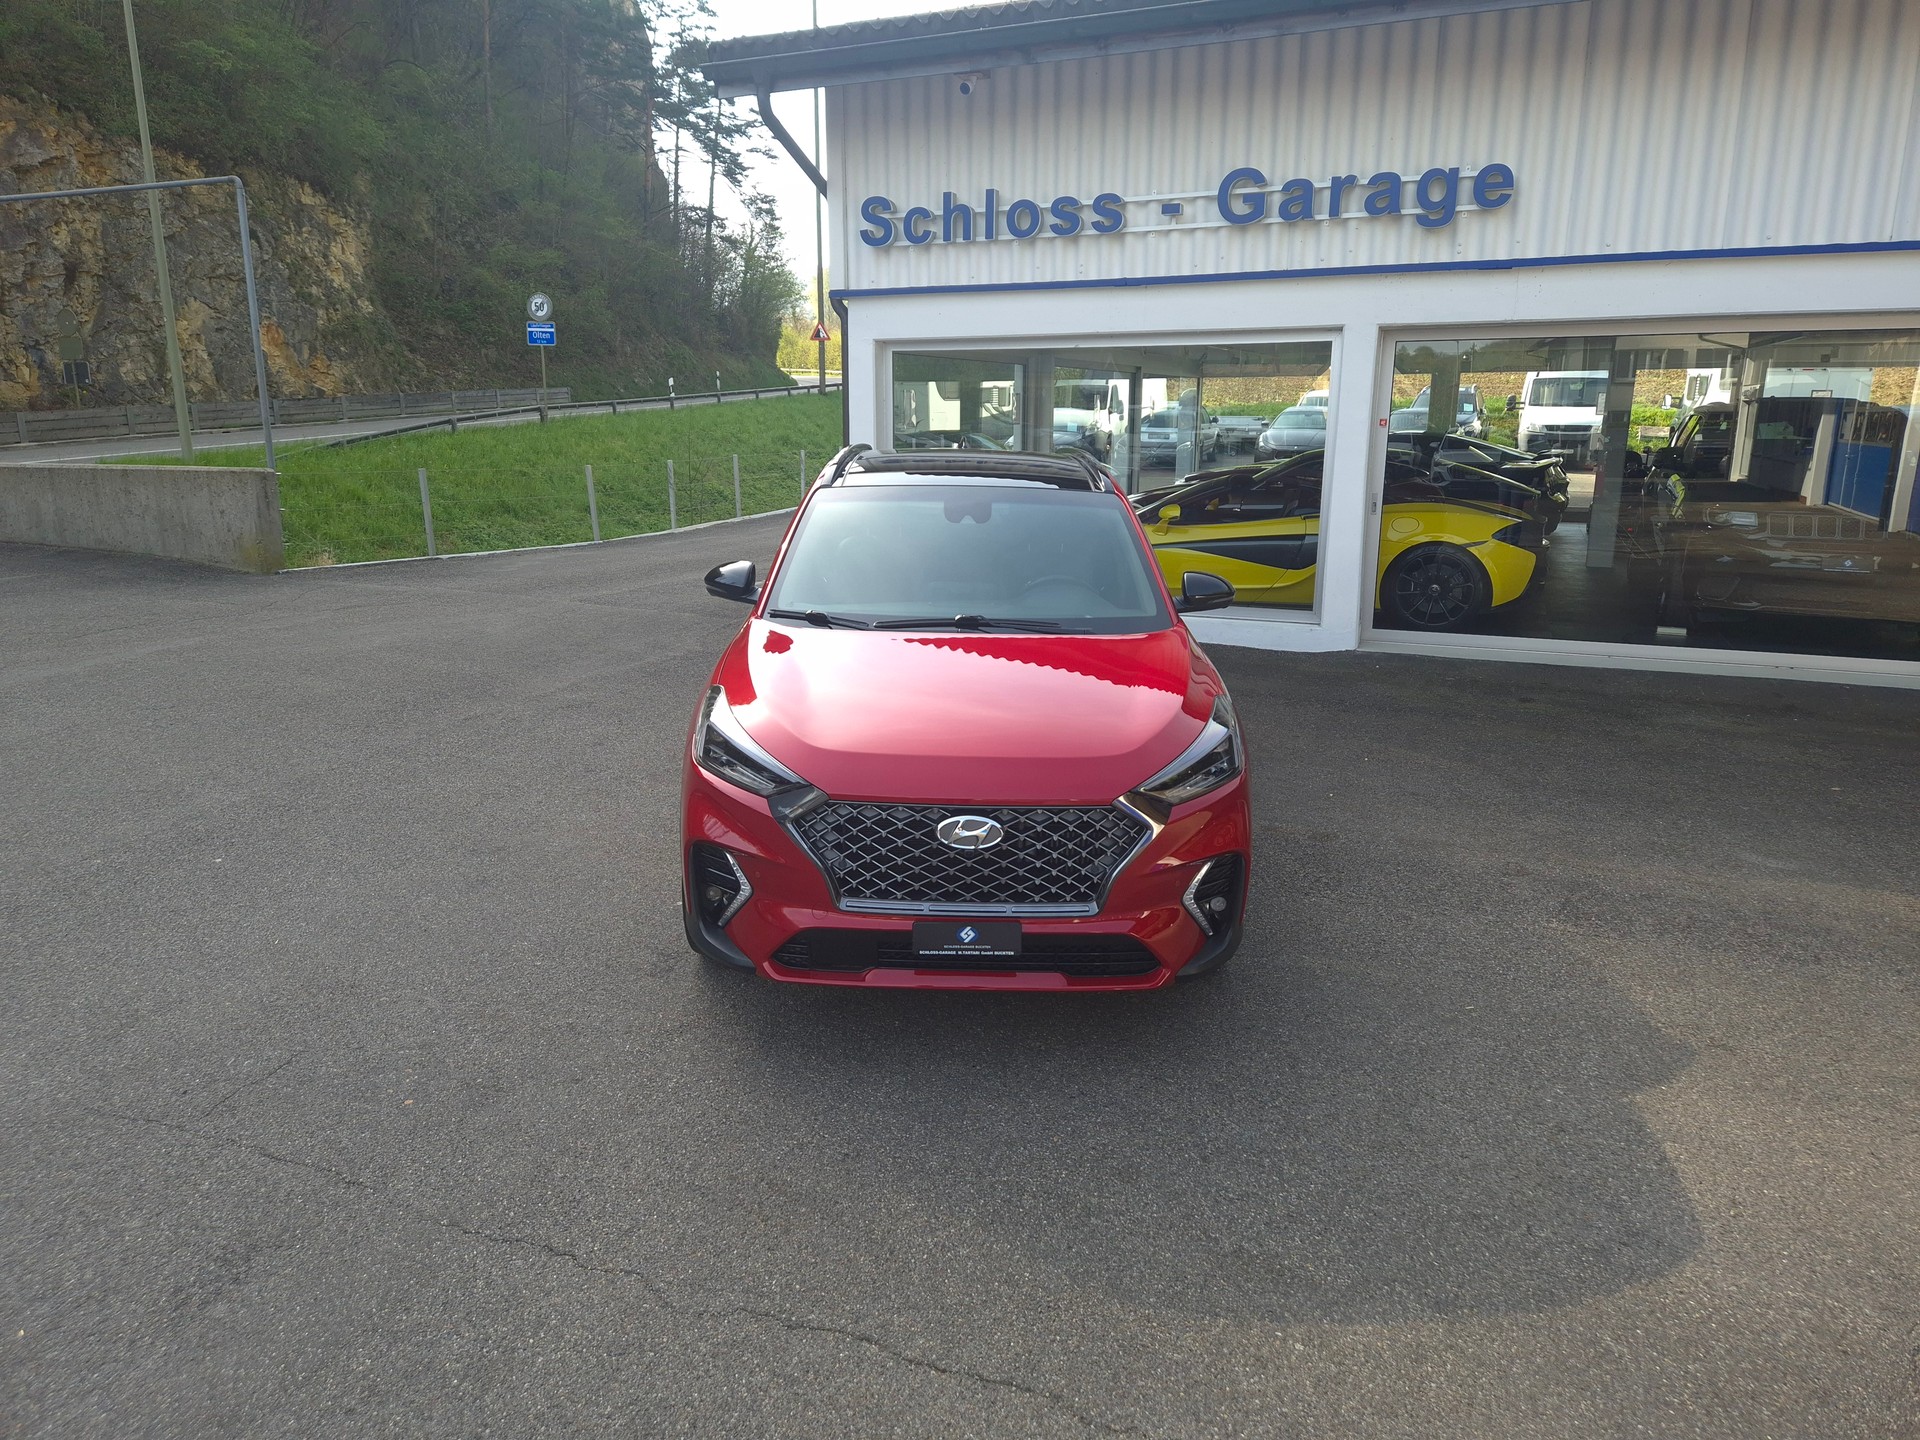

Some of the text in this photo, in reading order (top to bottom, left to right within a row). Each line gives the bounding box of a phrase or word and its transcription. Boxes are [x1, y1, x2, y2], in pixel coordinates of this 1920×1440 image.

[860, 188, 1126, 247] Schloss
[1217, 163, 1516, 229] Garage
[534, 302, 544, 312] 50
[532, 331, 551, 339] Olten
